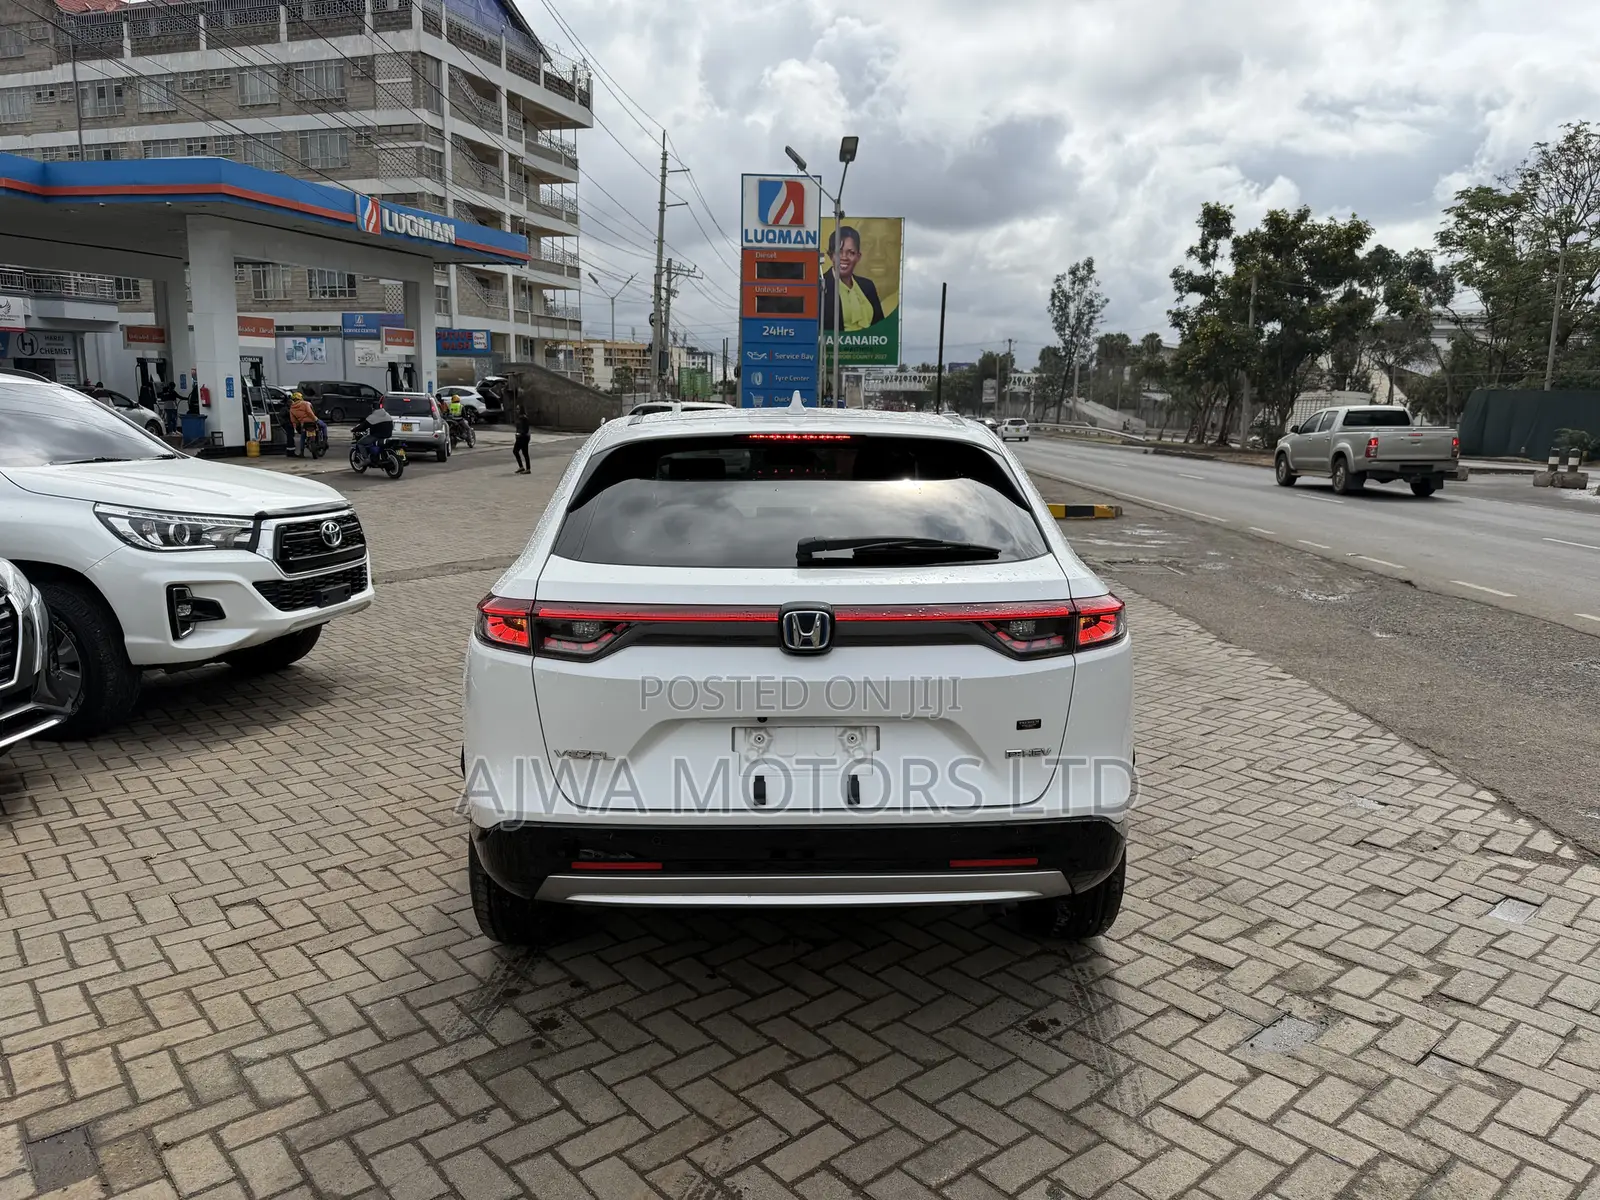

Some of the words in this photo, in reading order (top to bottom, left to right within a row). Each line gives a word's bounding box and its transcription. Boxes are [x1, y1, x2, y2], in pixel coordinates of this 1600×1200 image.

[382, 208, 455, 244] LUQMAN
[744, 229, 817, 244] LUQMAN
[762, 325, 795, 336] 24Hrs
[39, 347, 71, 355] CHEMIST
[801, 353, 814, 361] Bay
